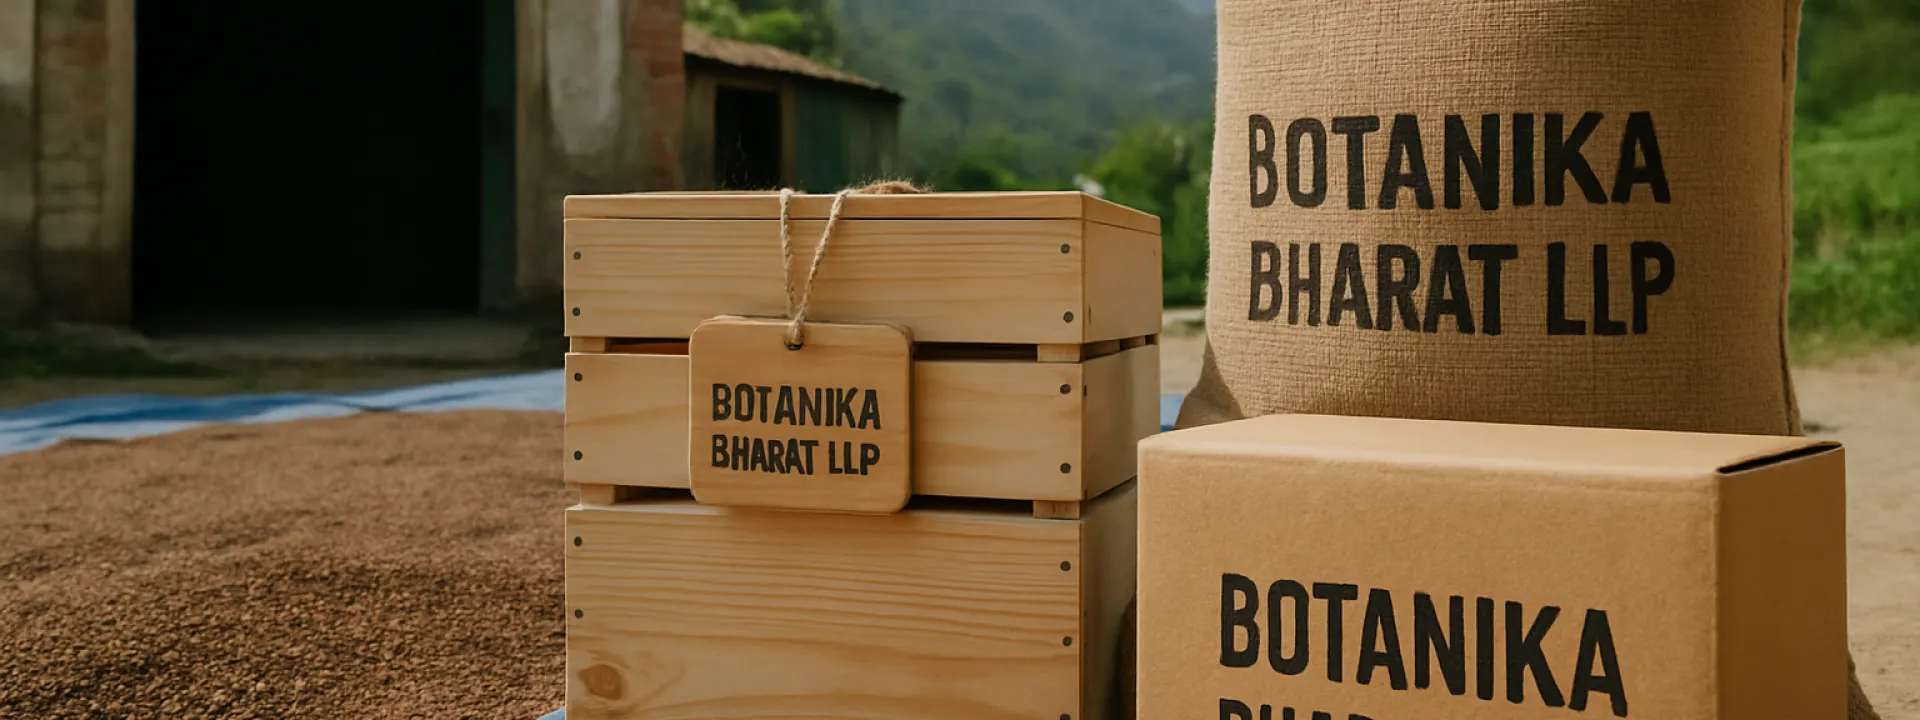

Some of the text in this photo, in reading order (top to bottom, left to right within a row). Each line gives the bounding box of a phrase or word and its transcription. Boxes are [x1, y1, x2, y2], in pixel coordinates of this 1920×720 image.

[1248, 111, 1671, 211] BOTANIKA
[1248, 240, 1676, 336] BHARAT LLP
[711, 383, 882, 430] BOTANIKA
[711, 434, 881, 476] BHARAT LLP
[1219, 573, 1628, 718] BOTANIKA
